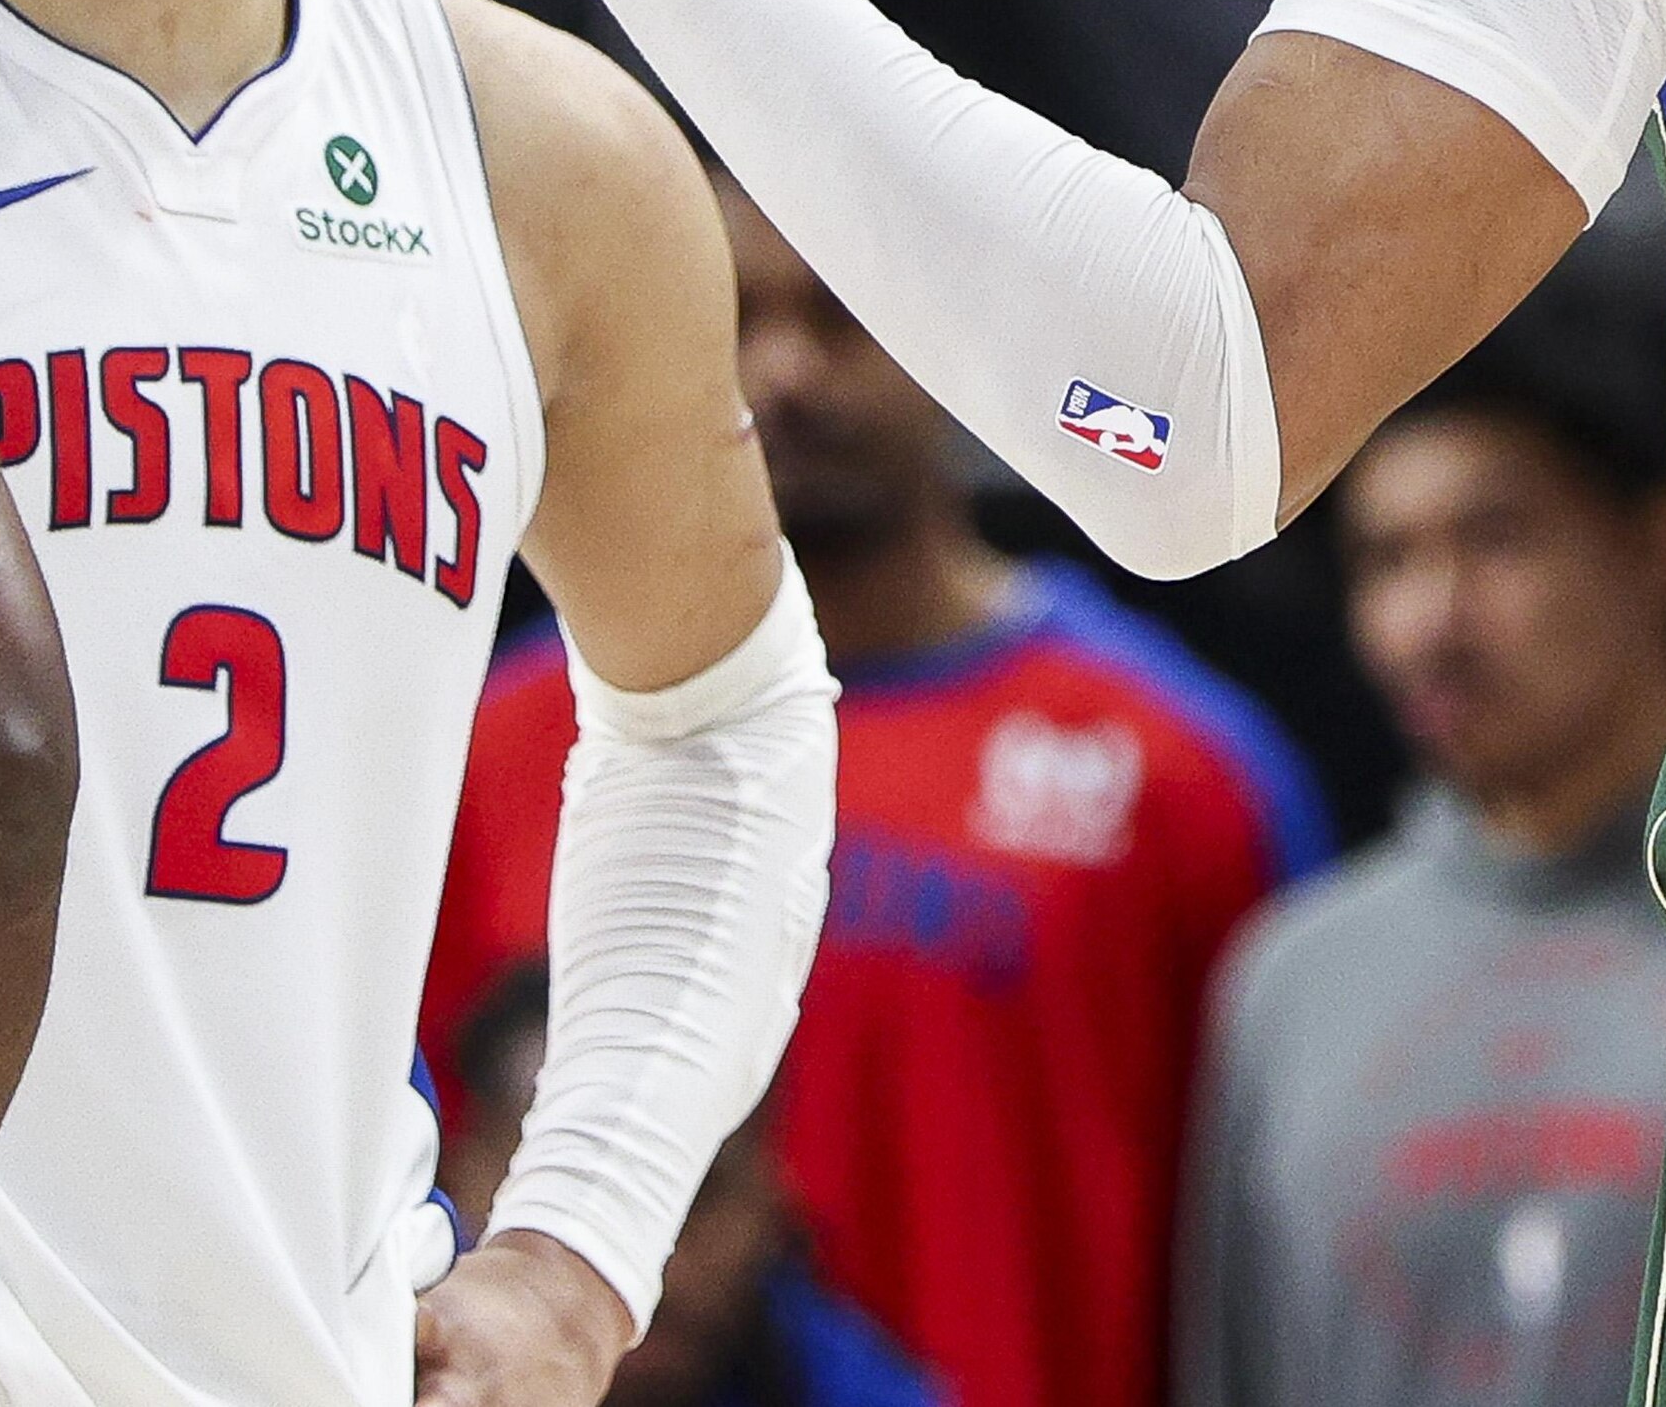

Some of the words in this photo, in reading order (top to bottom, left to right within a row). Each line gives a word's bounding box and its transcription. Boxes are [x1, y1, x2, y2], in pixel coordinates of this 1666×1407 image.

[296, 207, 432, 256] StockX
[1066, 385, 1091, 415] NBA
[145, 603, 287, 905] 2
